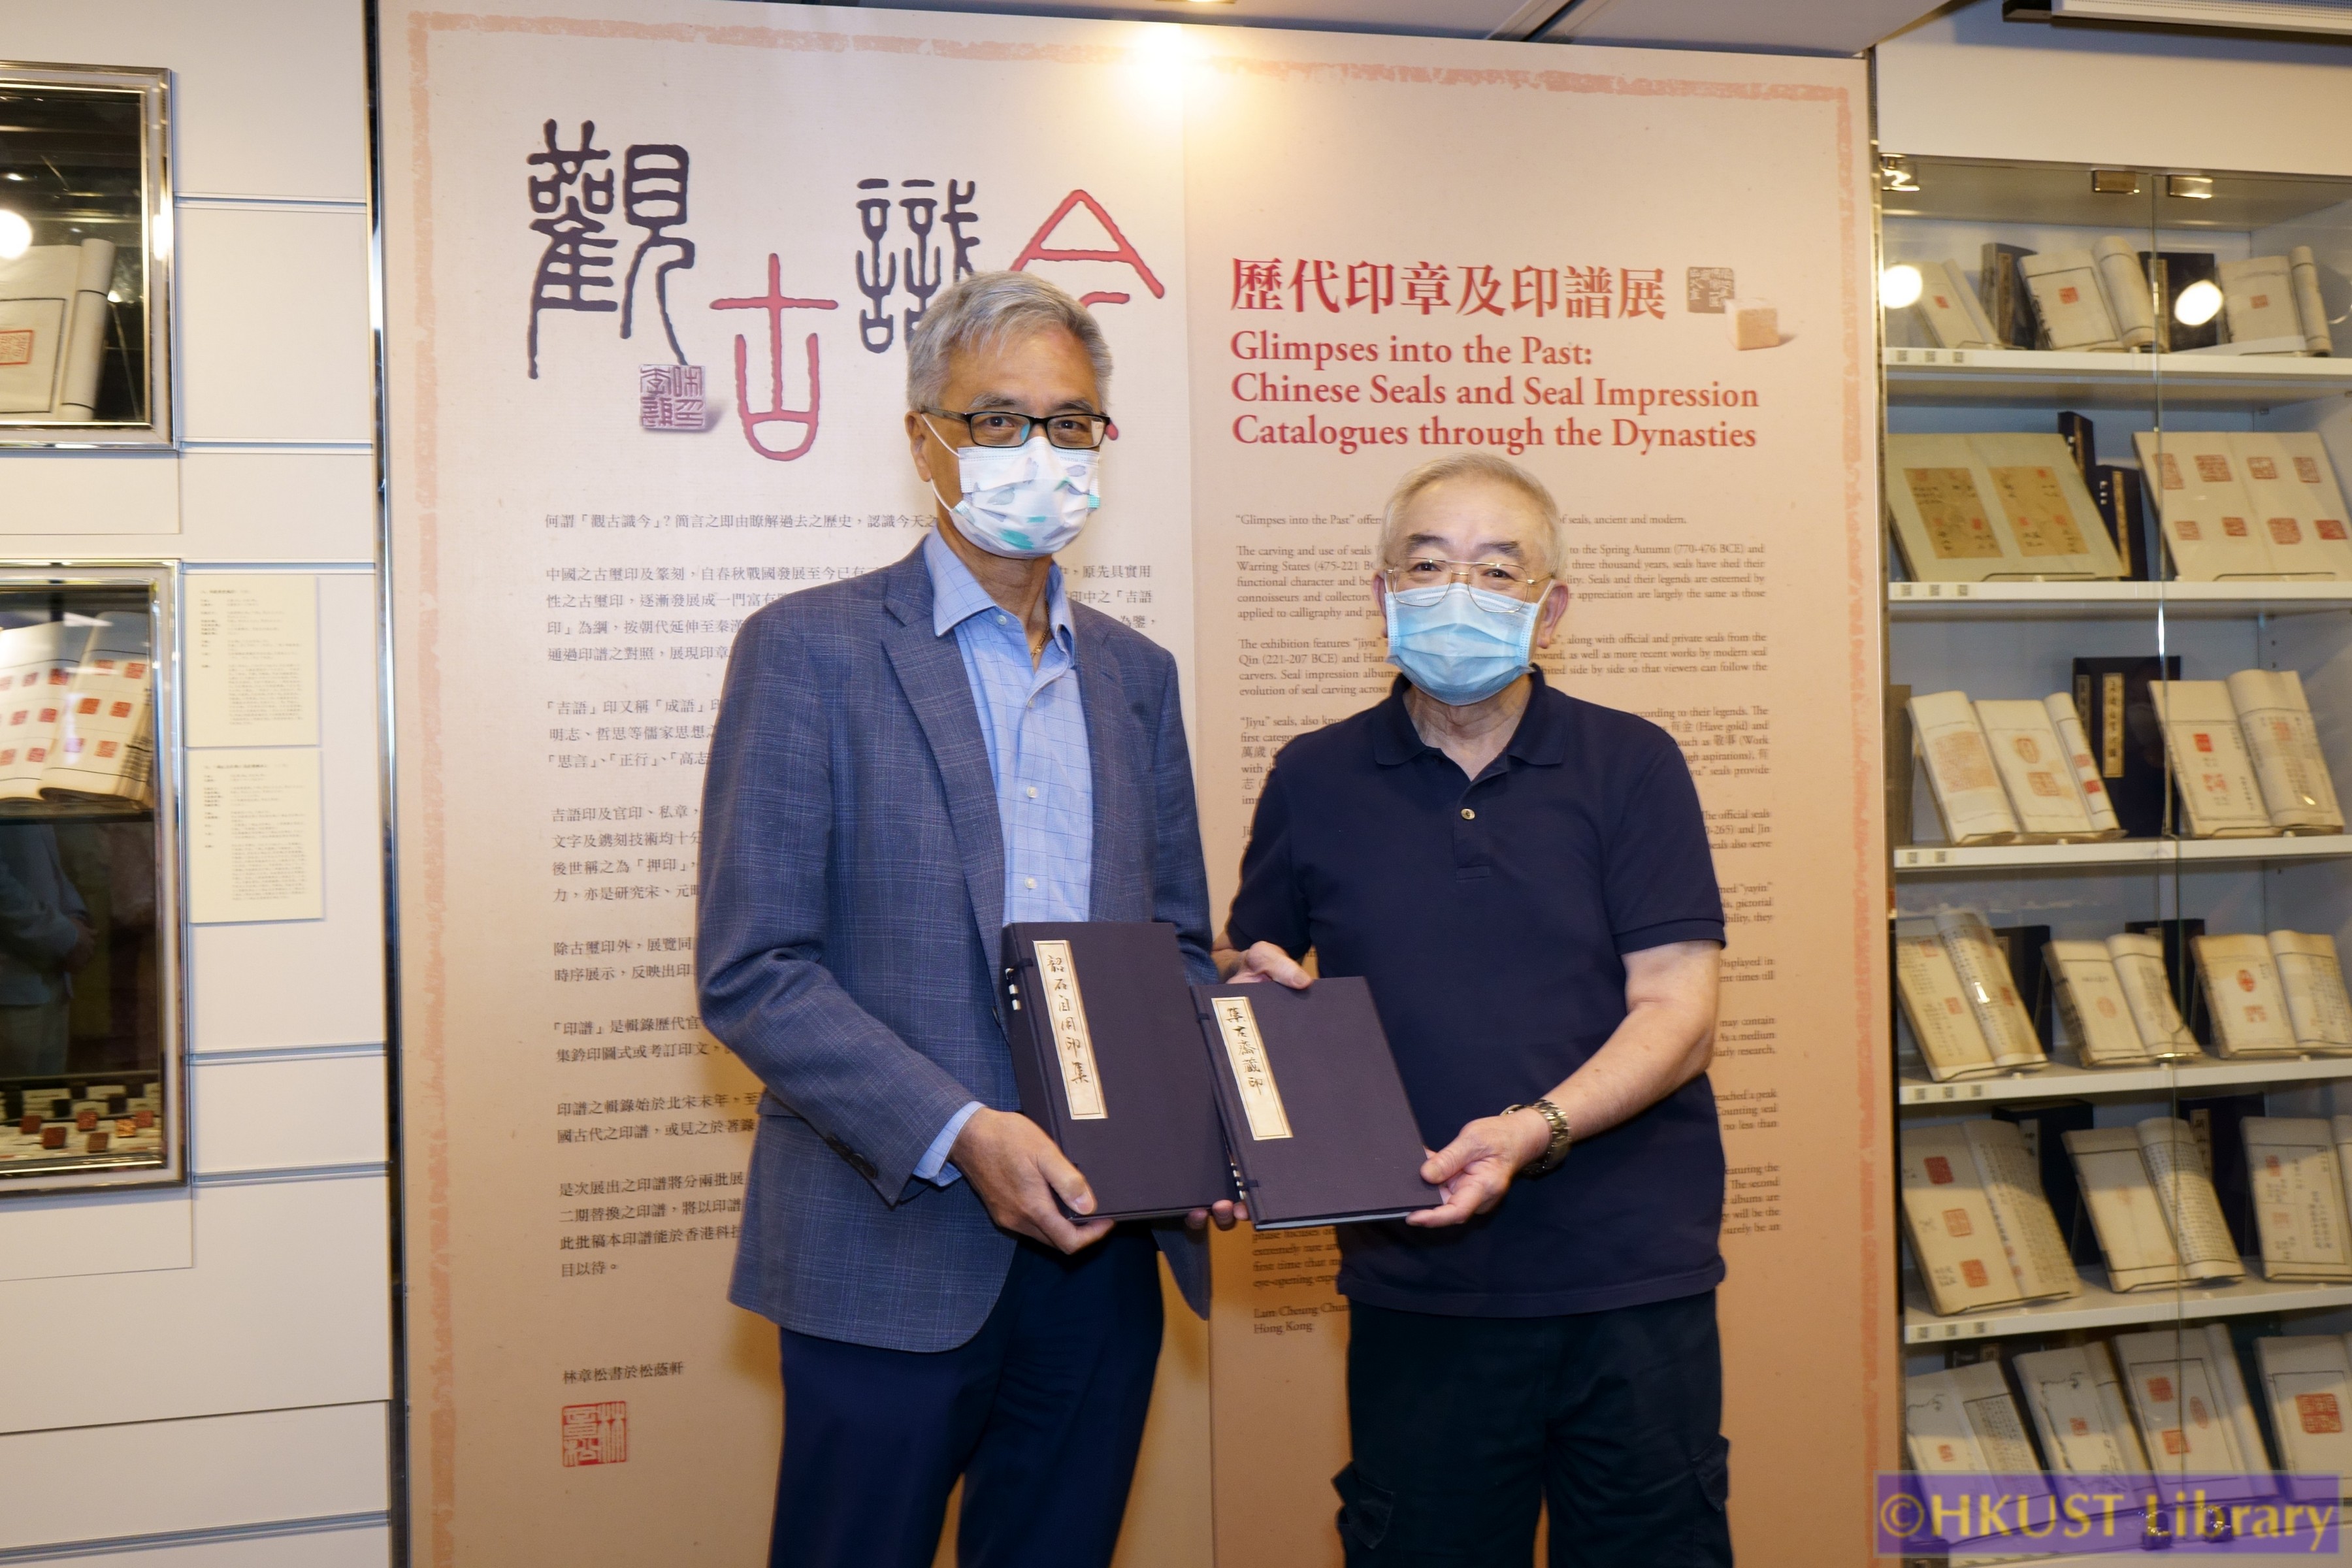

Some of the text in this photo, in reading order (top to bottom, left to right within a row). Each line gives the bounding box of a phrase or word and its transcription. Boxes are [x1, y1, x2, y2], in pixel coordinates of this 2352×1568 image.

[1231, 257, 1667, 320] 歷代印章及印譜展
[1230, 331, 1592, 370] Glimpses into the Past:
[1232, 372, 1759, 415] Chinese Seals and Seal Impression
[1232, 414, 1756, 455] Catalogues through the Dynasties
[1358, 514, 1382, 524] offer
[546, 566, 879, 581] 中國之古璽印及篆刻，自春秋戰國發展至今已有
[547, 593, 786, 608] 性之古璽印，逐漸發展成一門富有
